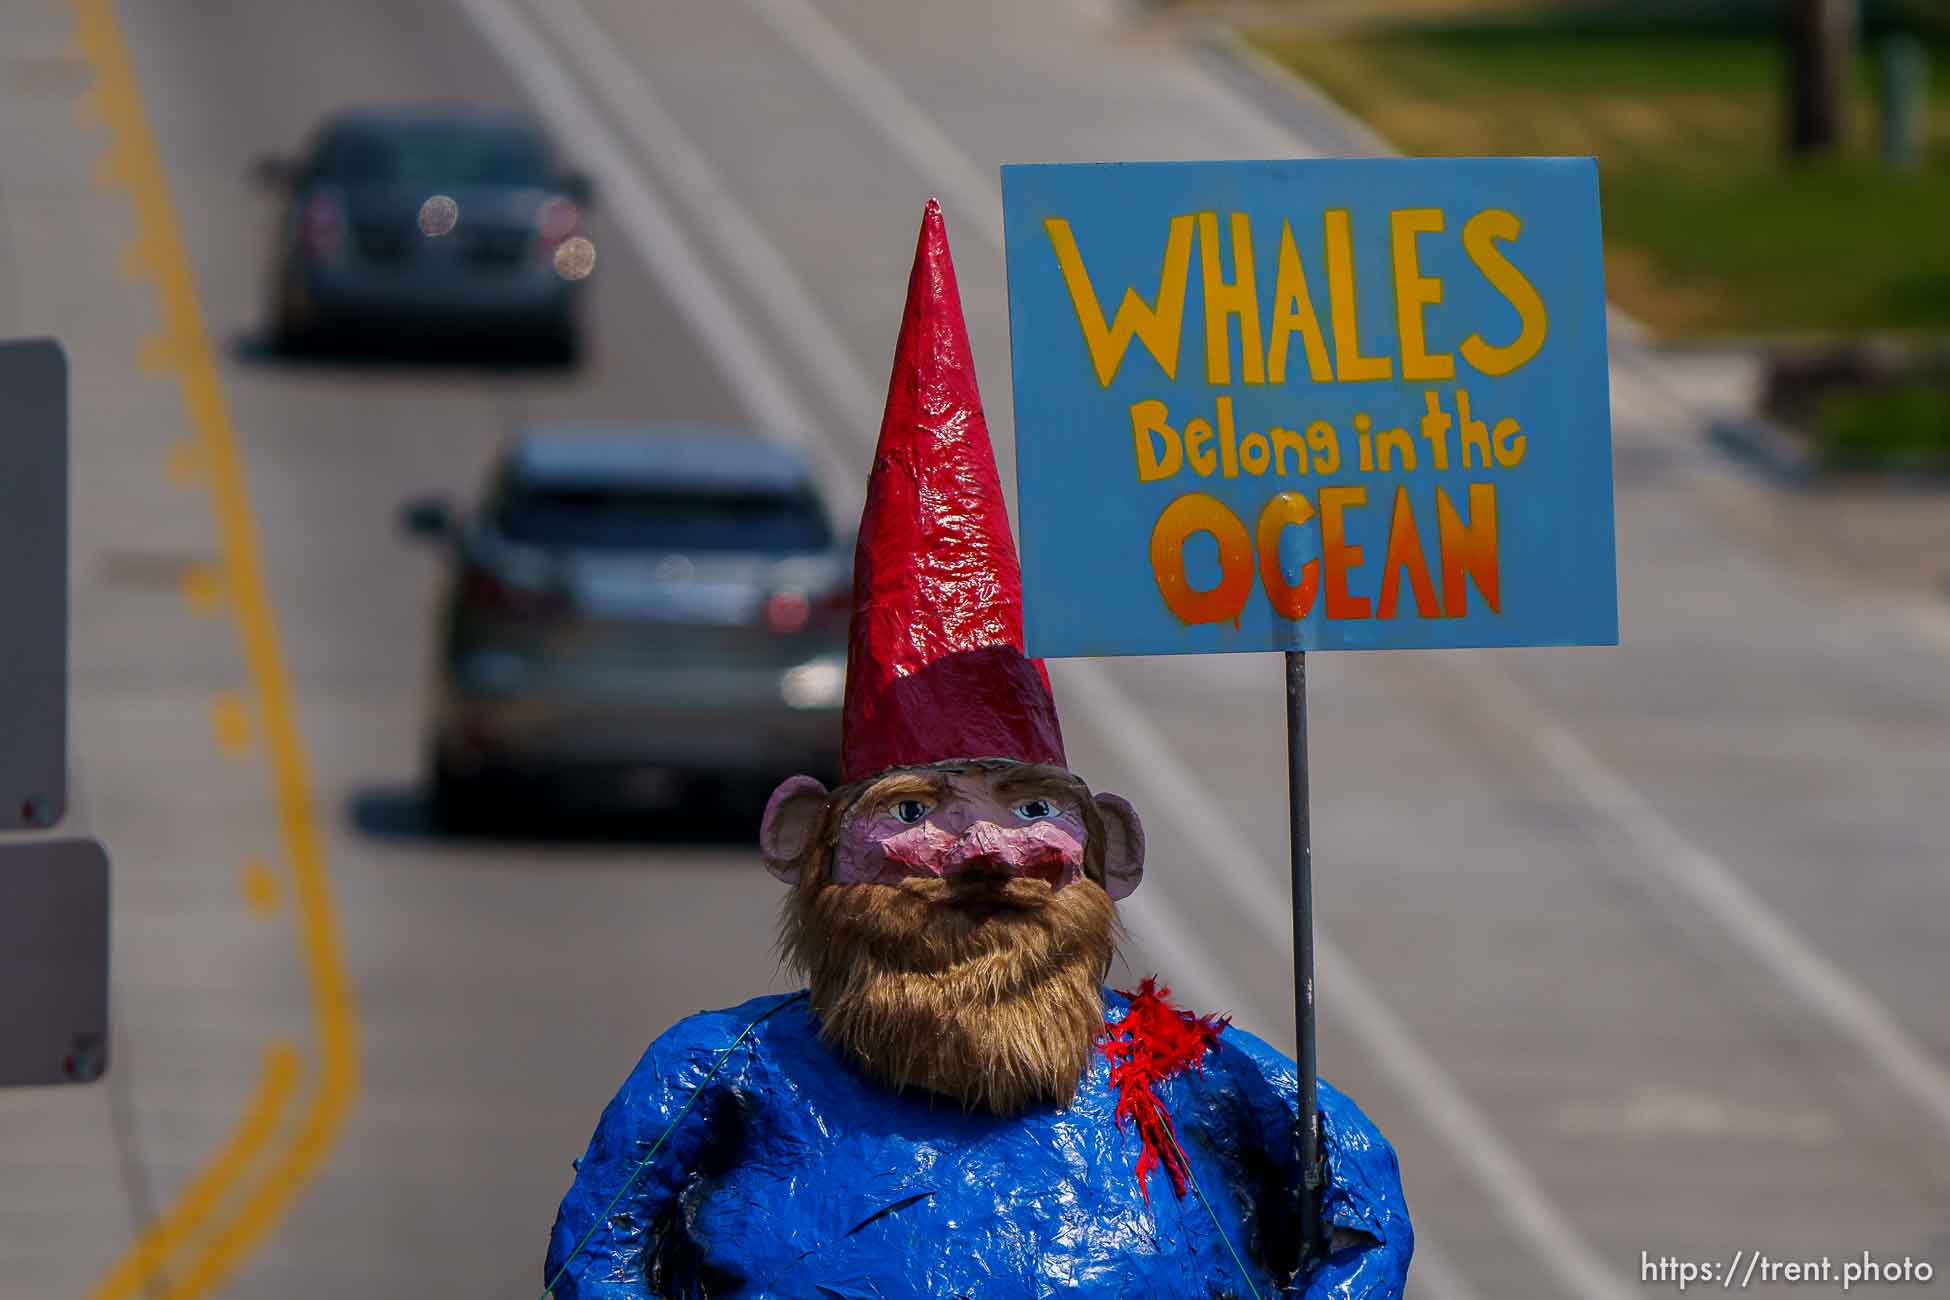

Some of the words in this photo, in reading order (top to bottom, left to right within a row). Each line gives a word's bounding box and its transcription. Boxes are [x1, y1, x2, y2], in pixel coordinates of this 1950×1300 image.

[1043, 207, 1549, 389] WHALES
[1129, 395, 1341, 483] Belong
[1352, 413, 1417, 472] in
[1421, 389, 1527, 470] the
[1149, 483, 1502, 629] OCEAN
